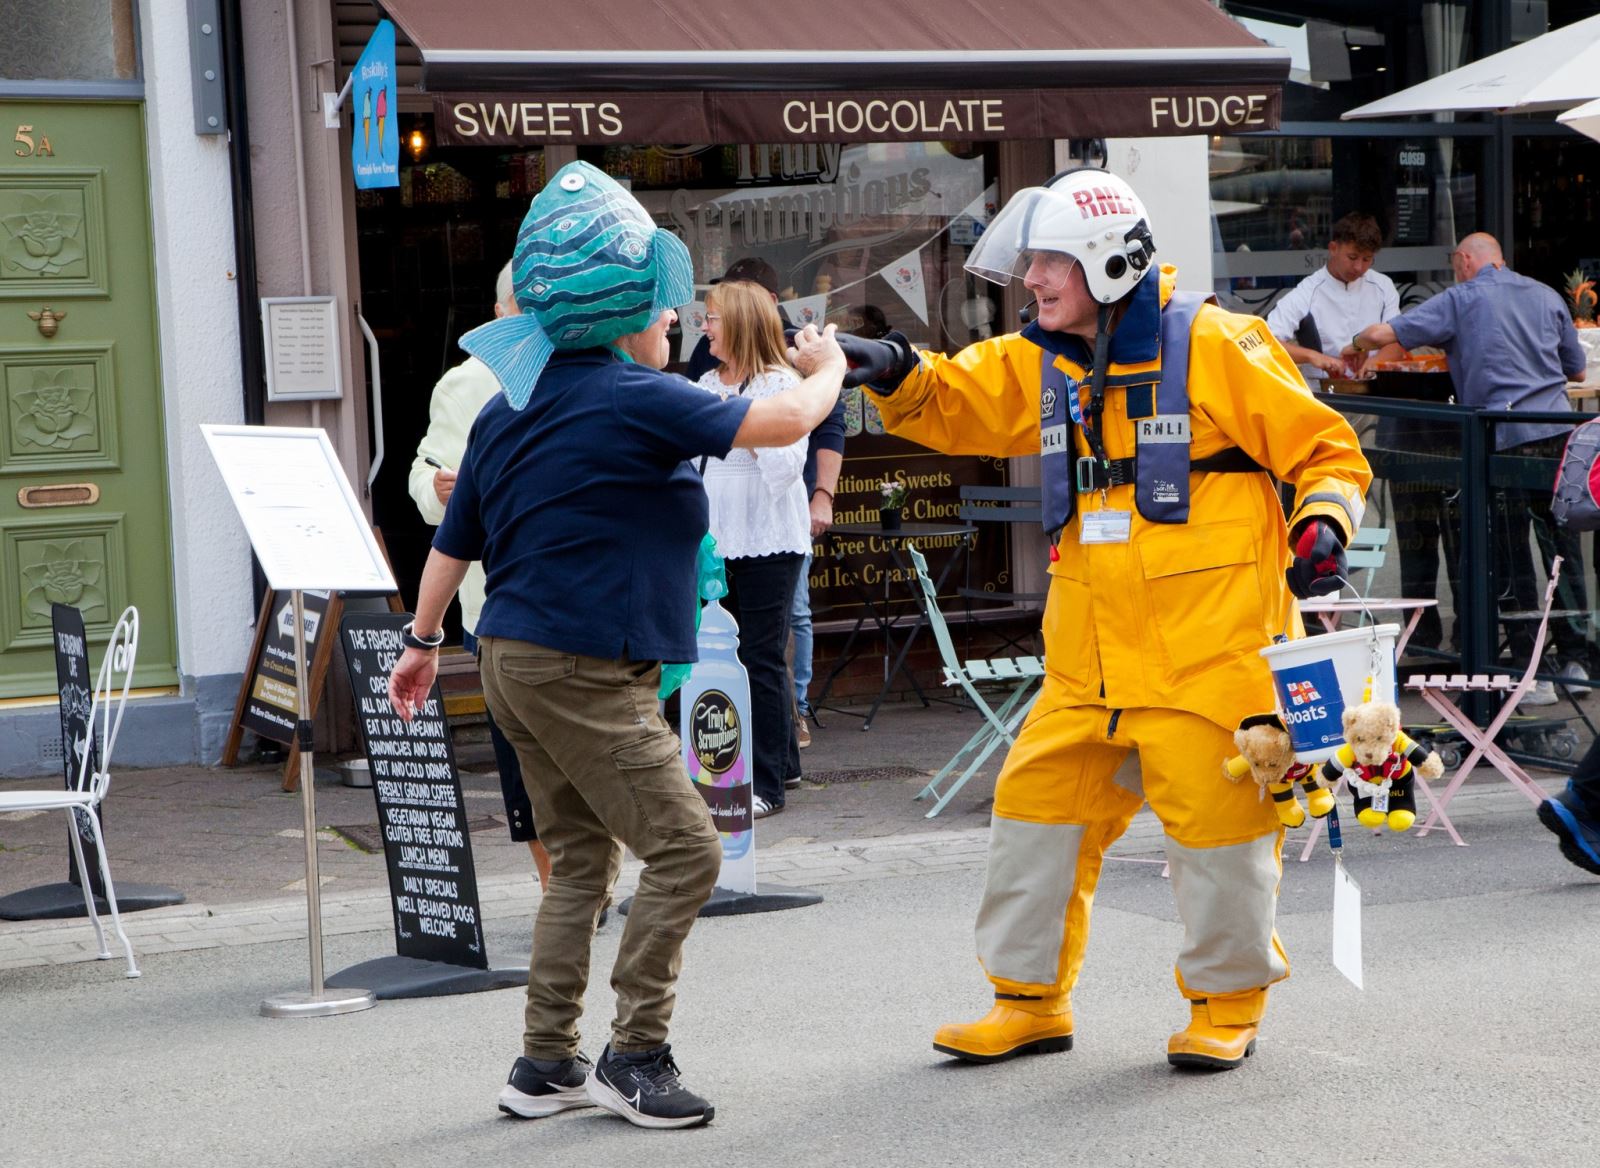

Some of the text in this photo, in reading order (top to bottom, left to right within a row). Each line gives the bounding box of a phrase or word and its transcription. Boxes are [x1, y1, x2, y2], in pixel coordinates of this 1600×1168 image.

[453, 95, 1267, 136] SWEETS CHOCOLATE FUDGE
[14, 125, 55, 157] 5A
[1400, 152, 1425, 165] CLOSED
[668, 162, 932, 250] Scrumptious
[1239, 329, 1265, 352] RNLI
[1143, 422, 1182, 435] RNLI
[1042, 433, 1061, 448] NLI
[834, 469, 952, 494] itional Sweets
[834, 499, 998, 525] andme Chocotes
[863, 563, 917, 584] Cram
[349, 629, 404, 650] THE FISHERMA
[377, 652, 398, 672] CAFE
[362, 697, 392, 714] ALL DAY
[1287, 705, 1327, 724] boats
[696, 703, 726, 731] Truly
[366, 719, 444, 738] EAT IN OR TAKEAWAY
[698, 728, 738, 750] Scrumptious
[369, 740, 447, 758] SANDWICHES AND BAPS
[374, 760, 451, 780] HOT AND COLD DRINKS
[377, 780, 403, 797] FRESHLY
[404, 782, 430, 799] GROUND
[431, 784, 456, 801] COFFEE
[386, 808, 455, 829] VEGETARIAN VEGAN
[385, 825, 464, 848] GLUTEN FREE OPTIONS
[400, 846, 449, 865] LUNCH MENU
[403, 876, 458, 899] DAILY SPECIALS
[397, 896, 475, 924] WELL BEHAVED DOGS
[419, 917, 457, 939] WELCOME
